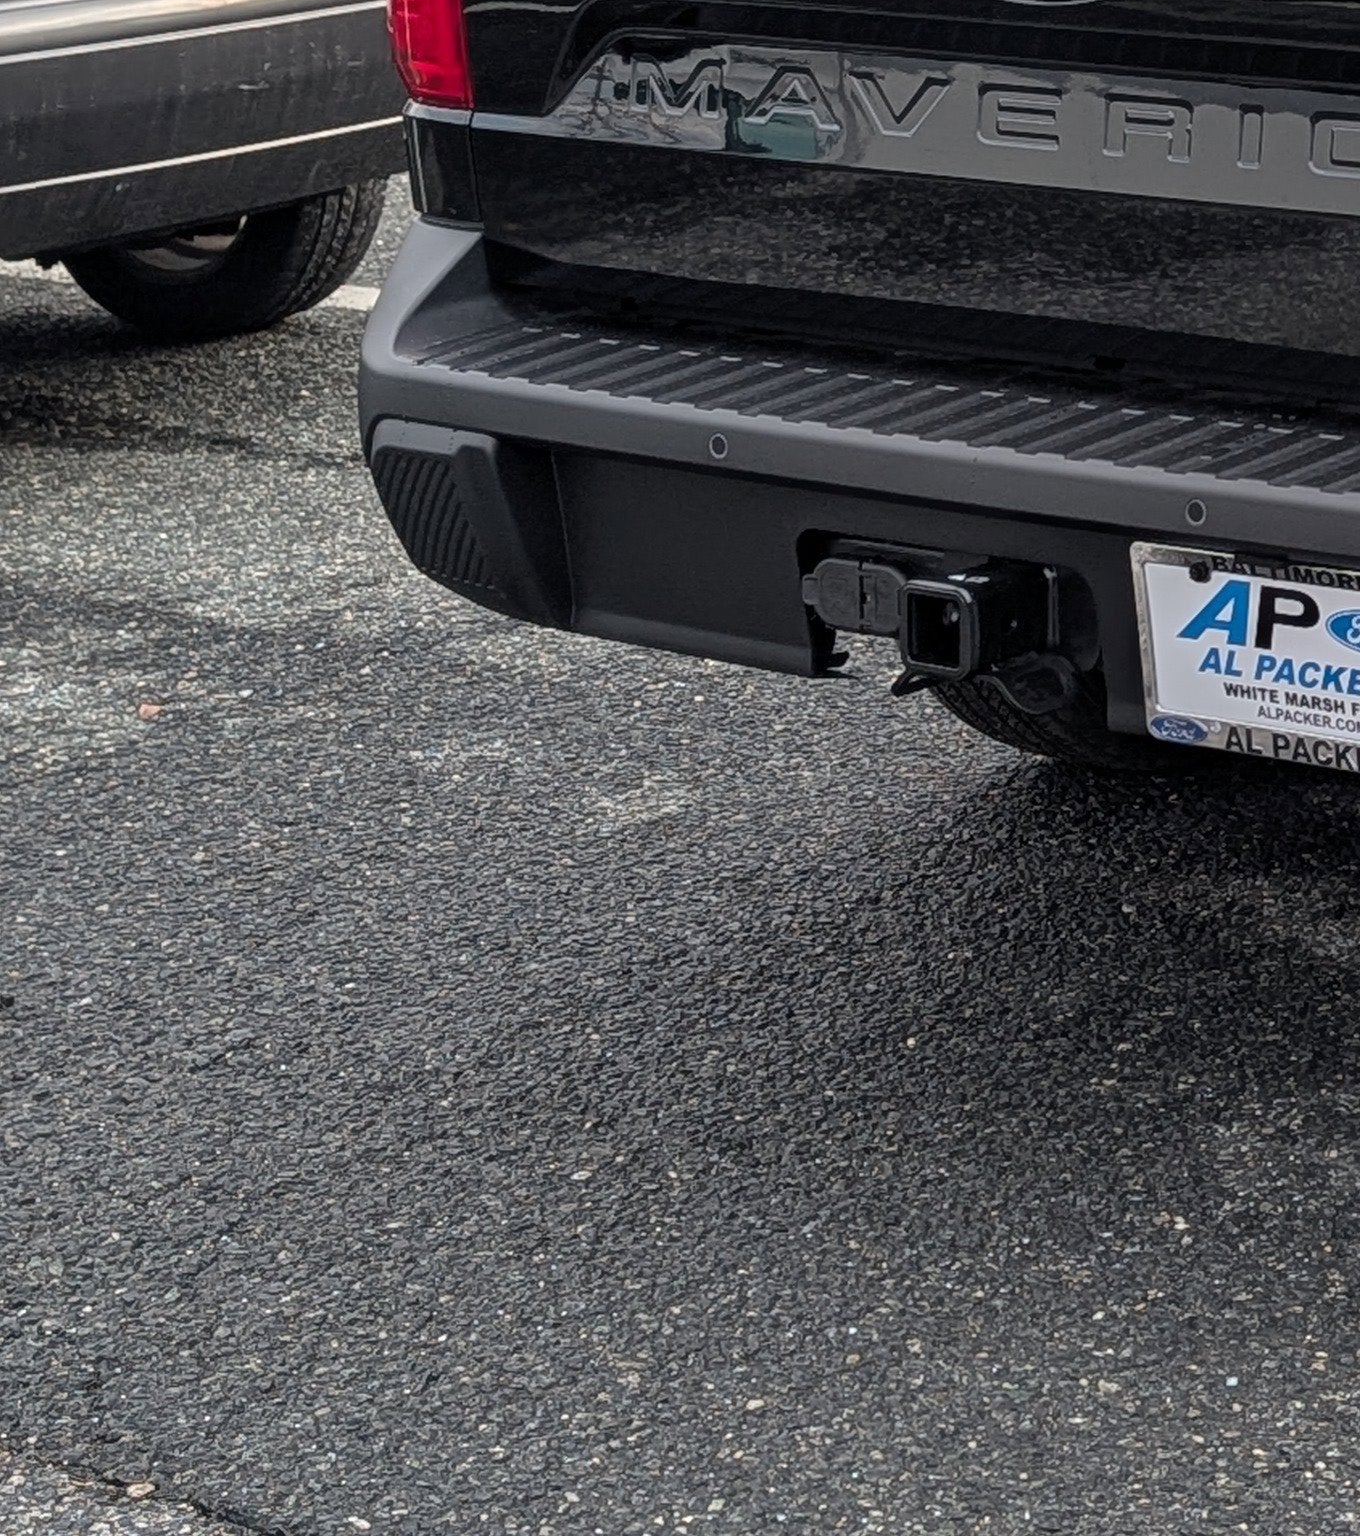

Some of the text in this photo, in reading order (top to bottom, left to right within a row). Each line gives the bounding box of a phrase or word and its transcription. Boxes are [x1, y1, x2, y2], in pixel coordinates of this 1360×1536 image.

[1177, 579, 1320, 650] AP
[1199, 647, 1244, 677] AL
[1223, 682, 1281, 705] WHITE
[1285, 692, 1345, 715] MARSH
[1225, 727, 1264, 755] AL
